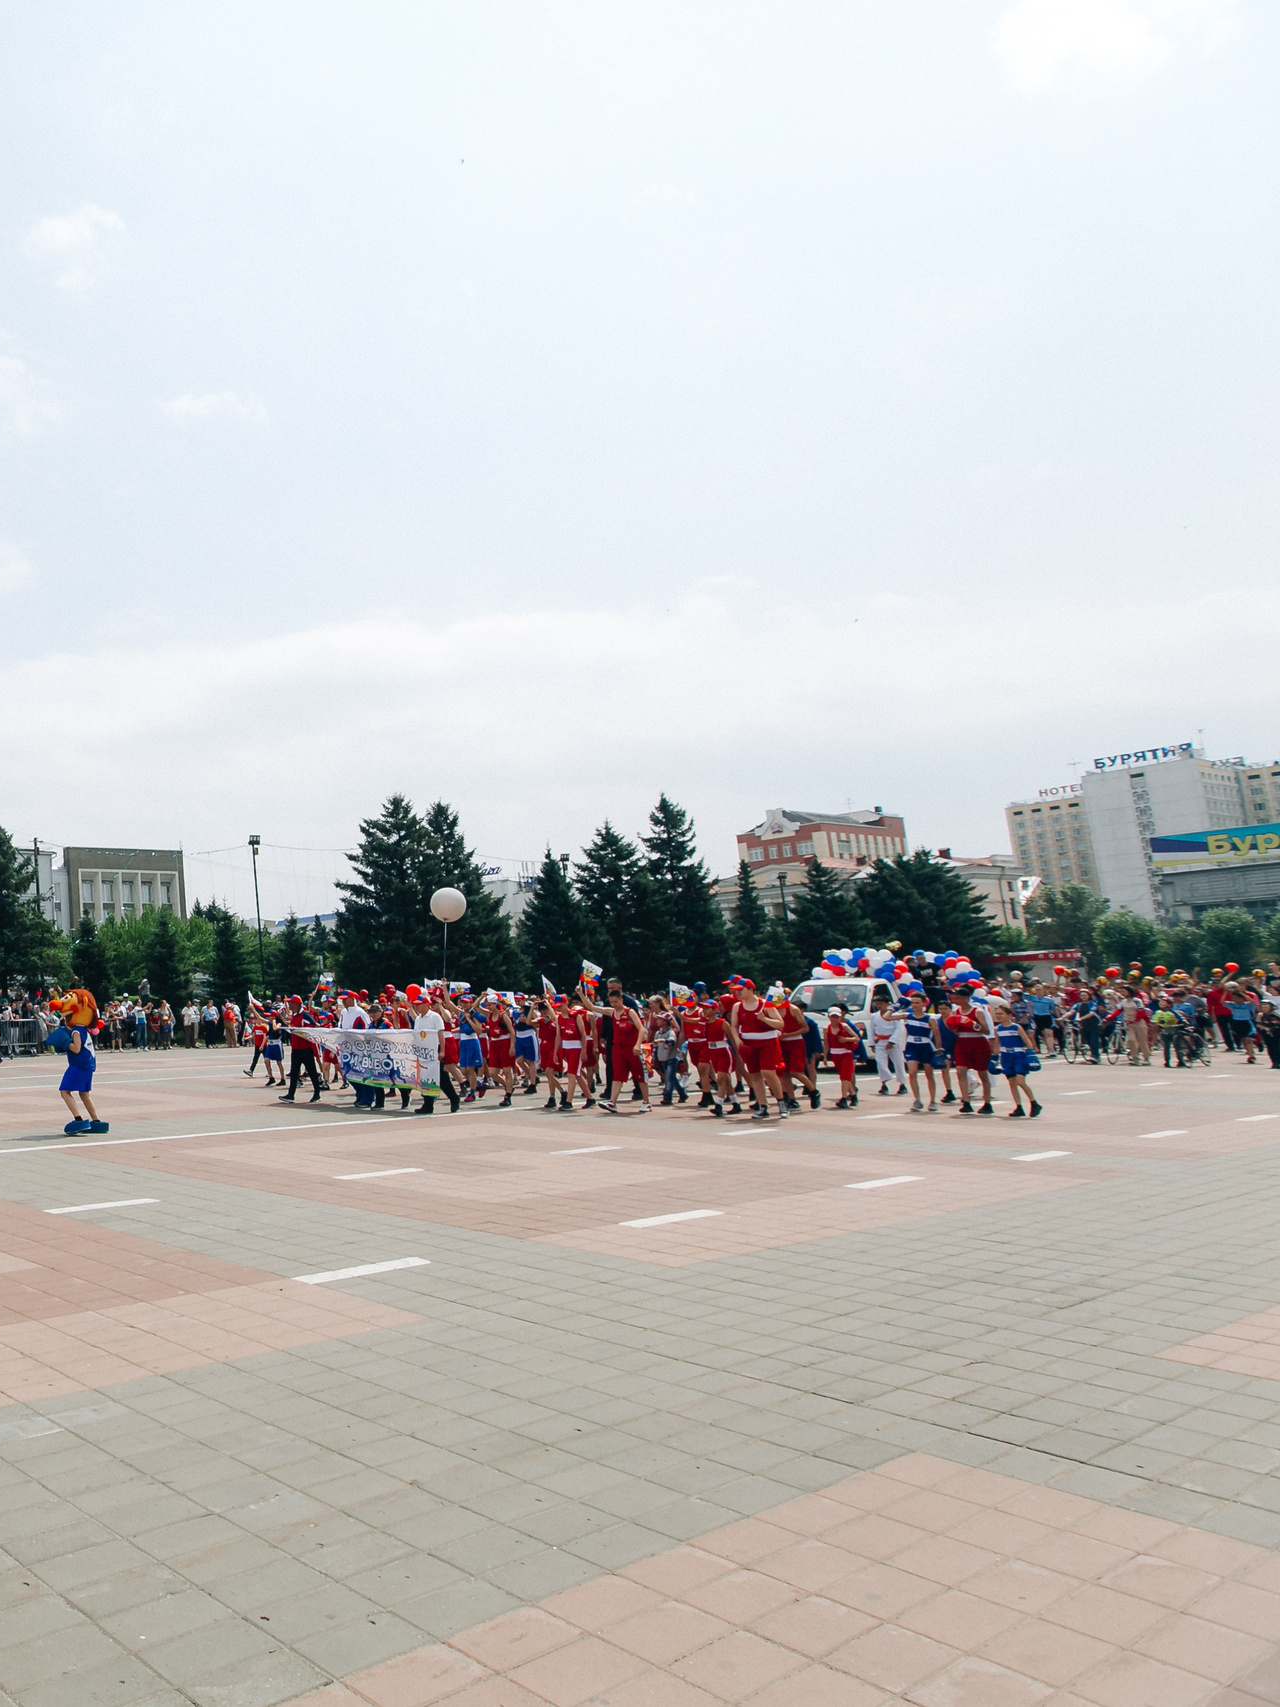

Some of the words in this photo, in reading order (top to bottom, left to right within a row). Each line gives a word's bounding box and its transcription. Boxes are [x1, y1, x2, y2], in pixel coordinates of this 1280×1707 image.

[1093, 742, 1192, 769] БУРЯТИЯ
[1206, 832, 1280, 856] Бур
[362, 1056, 405, 1071] ВЫБОР!
